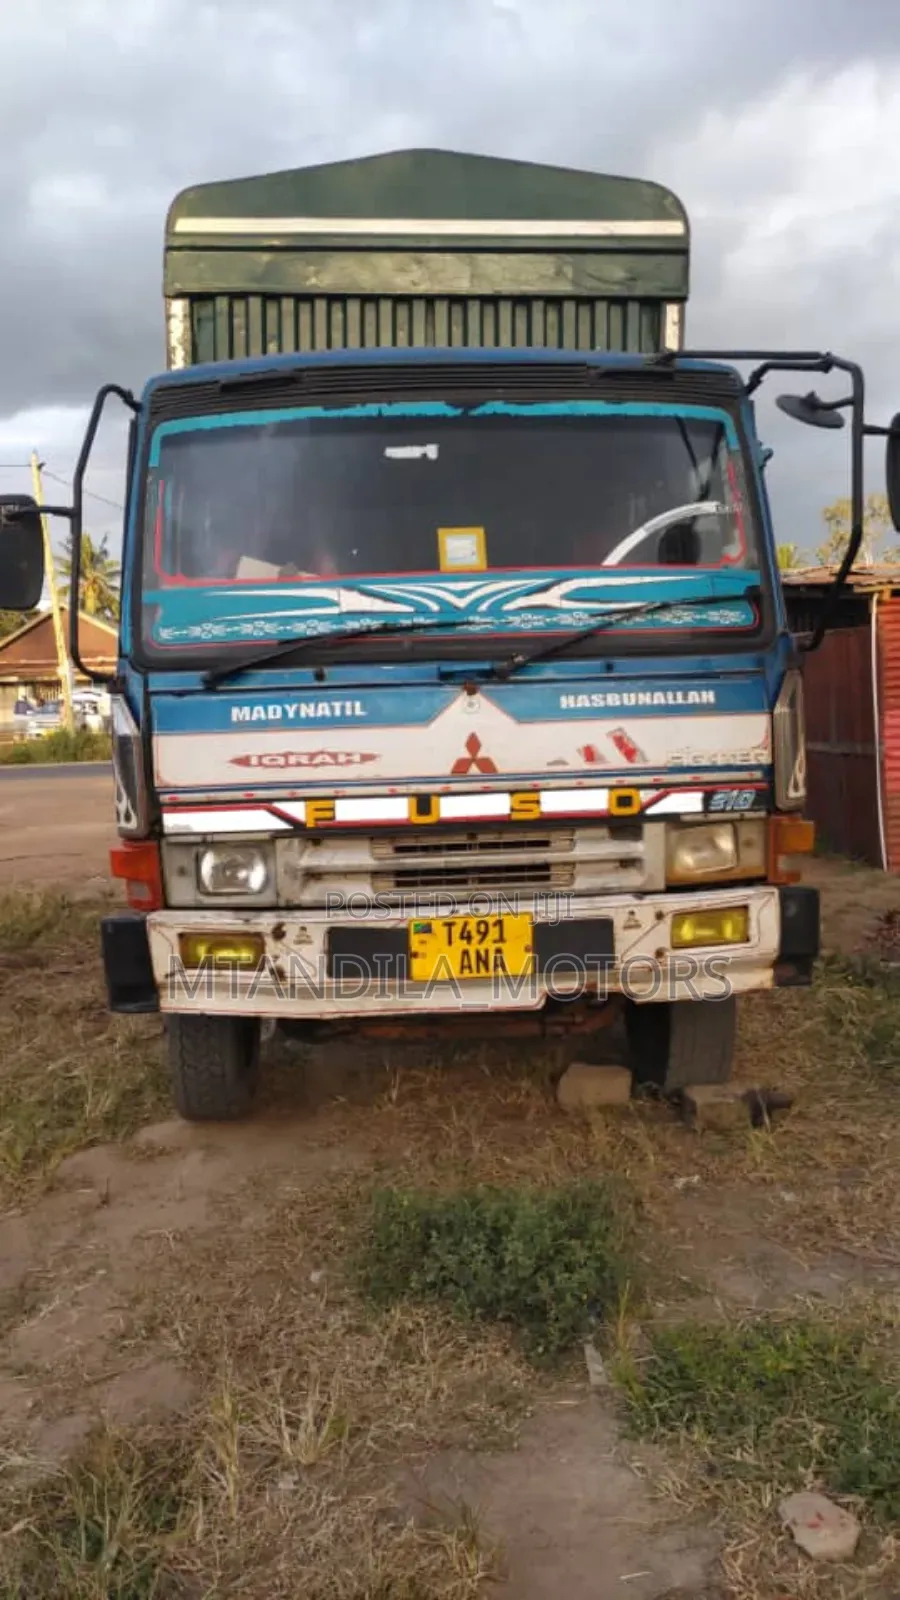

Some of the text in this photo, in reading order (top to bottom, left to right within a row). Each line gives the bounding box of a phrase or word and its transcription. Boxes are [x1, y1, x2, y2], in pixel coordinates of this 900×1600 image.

[231, 701, 368, 722] MADYNATIL
[560, 690, 716, 709] HASBUNALLAH
[249, 752, 362, 767] IQRAH
[303, 787, 642, 828] FUSO
[442, 918, 507, 947] T491
[459, 946, 508, 975] ANA
